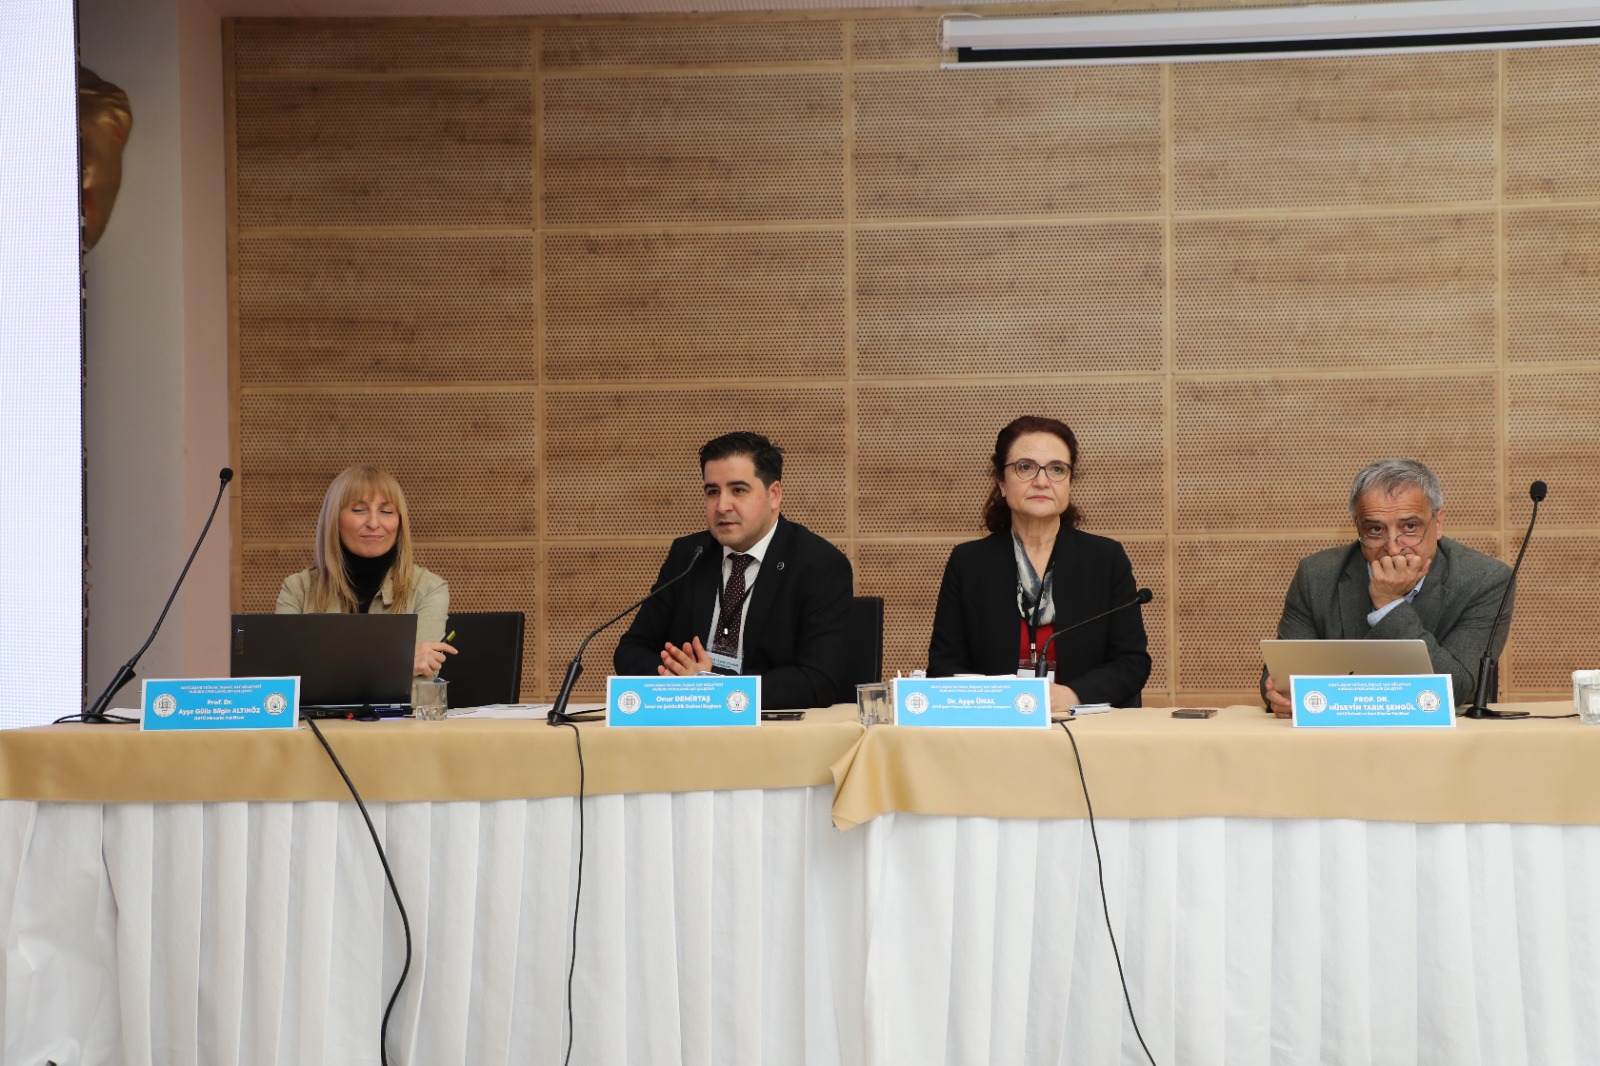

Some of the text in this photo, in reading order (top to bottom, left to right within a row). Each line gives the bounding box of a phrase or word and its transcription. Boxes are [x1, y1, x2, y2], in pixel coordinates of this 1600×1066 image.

[674, 695, 711, 703] DEMİRTAŞ
[957, 698, 975, 706] Ayşe
[178, 708, 194, 716] Ayşe
[212, 708, 231, 716] Bilgin
[232, 706, 261, 714] ALTINÖZ
[1328, 703, 1362, 711] HÜSEYİN
[1385, 703, 1416, 712] ŞENGÜL
